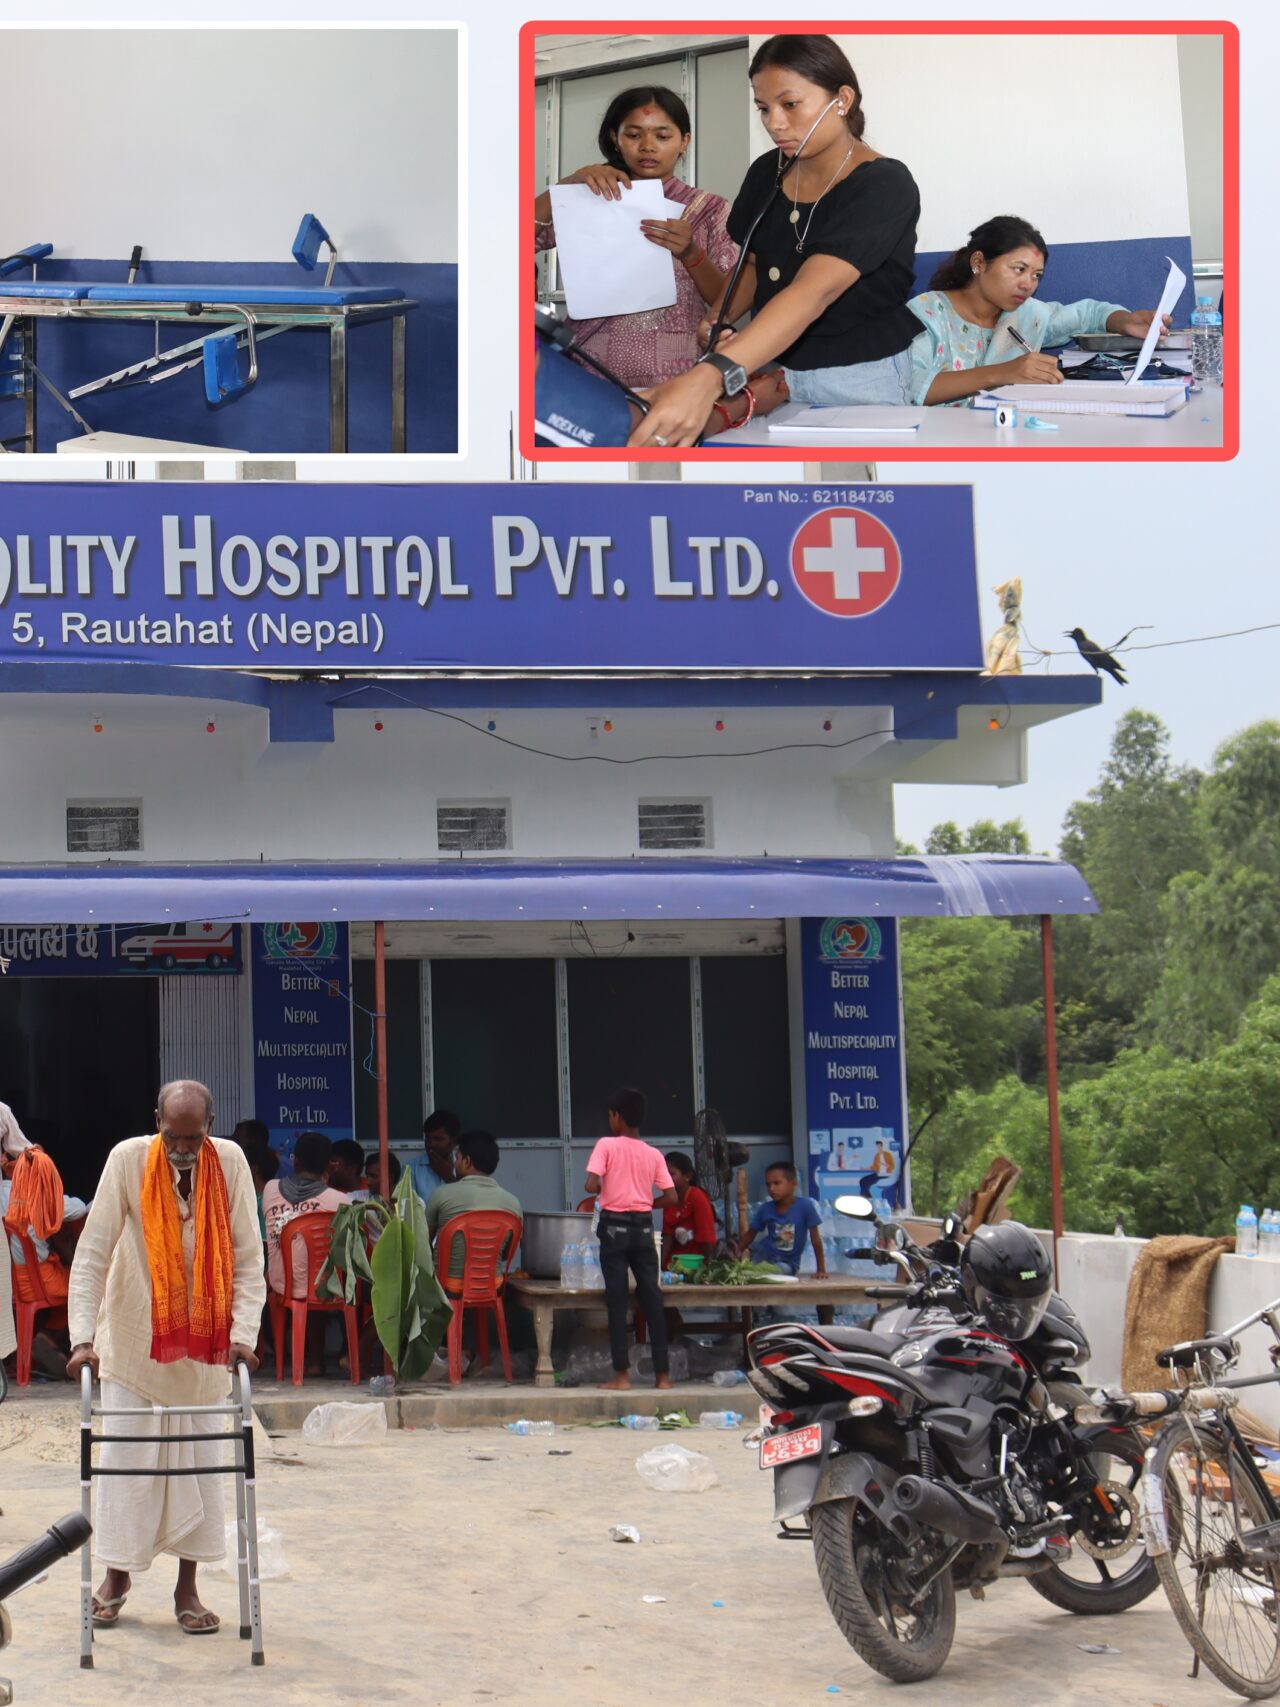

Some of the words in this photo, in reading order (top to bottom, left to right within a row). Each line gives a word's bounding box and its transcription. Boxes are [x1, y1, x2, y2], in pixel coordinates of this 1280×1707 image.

[744, 489, 773, 503] Pan
[777, 489, 808, 503] No.:
[812, 489, 895, 504] 621184736
[162, 515, 470, 607] HOSPITAL
[492, 515, 626, 598] PVT.
[651, 515, 779, 599] LTD.
[12, 612, 44, 649] 5,
[61, 612, 234, 645] Rautahat
[247, 612, 384, 652] (Nepal)
[281, 973, 321, 991] BETTER
[831, 971, 870, 989] BETTER
[284, 1006, 320, 1026] NEPAL
[833, 1001, 870, 1020] NEPAL
[257, 1039, 348, 1060] MULTISPECIALITY
[808, 1031, 897, 1051] MULTISPECIALITY
[827, 1061, 880, 1081] HOSPITAL
[277, 1072, 330, 1092] HOSPITAL
[829, 1091, 854, 1110] PVT.
[856, 1091, 880, 1110] LTD.
[279, 1106, 303, 1124] PVT.
[306, 1106, 329, 1124] LTD.
